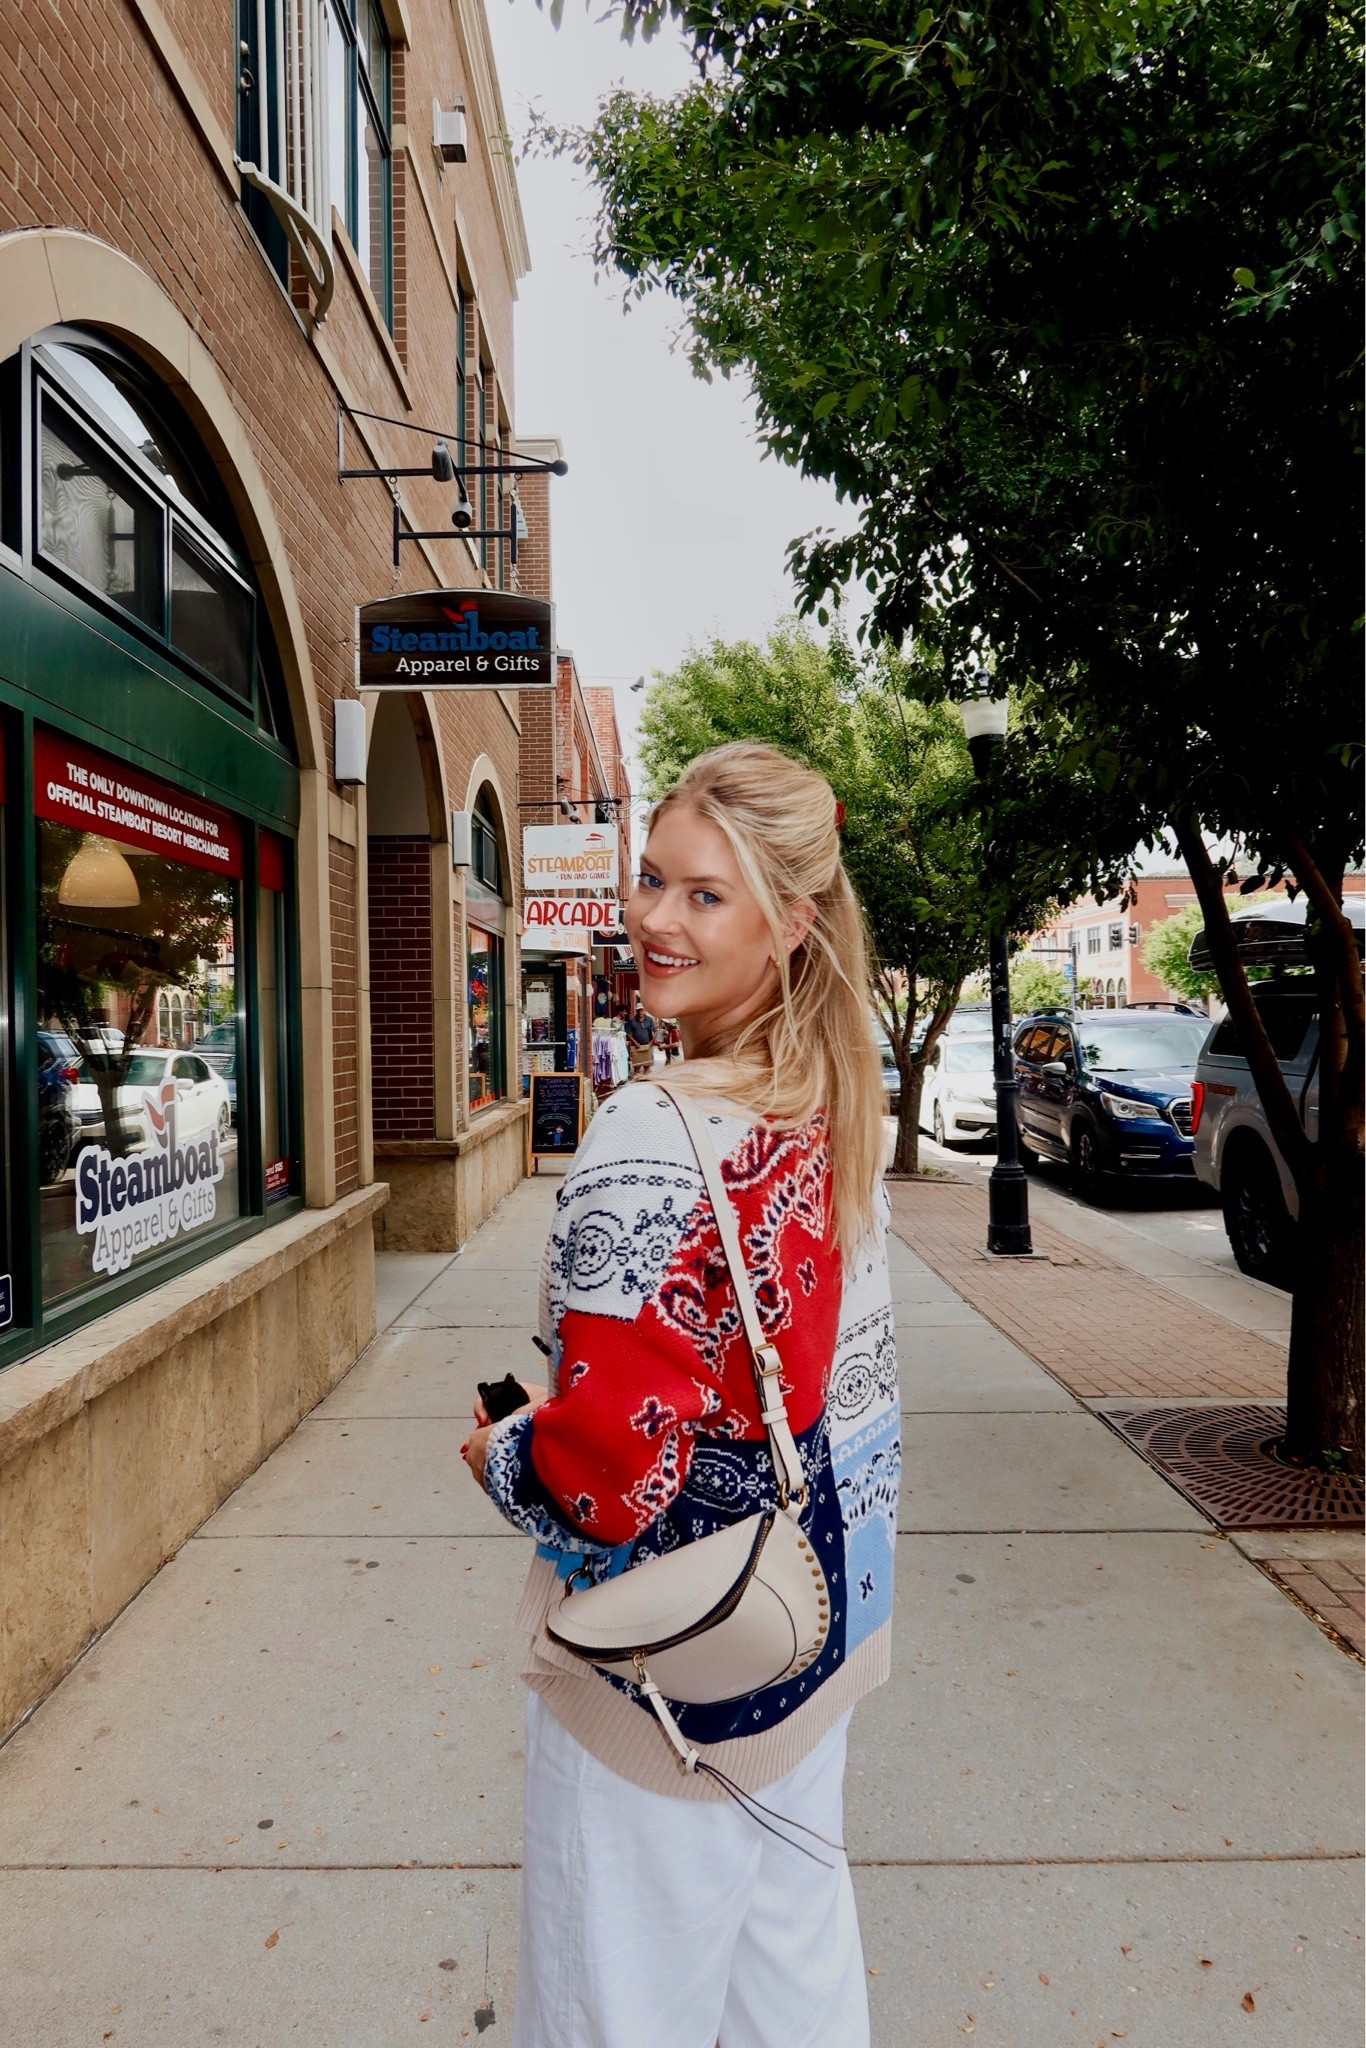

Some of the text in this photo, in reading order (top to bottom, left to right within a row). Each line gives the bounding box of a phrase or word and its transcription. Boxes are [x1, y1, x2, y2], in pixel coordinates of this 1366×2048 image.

[371, 611, 540, 654] Steamboat
[395, 655, 540, 676] Apparel & Gifts
[46, 781, 230, 862] OFFICIAL STEAMBOAT RESORT MERCHANDISE
[66, 762, 219, 838] THE ONLY DOWNTOWN LOCATION FOR
[527, 855, 614, 874] STEAMBOAT
[526, 900, 617, 928] ARCADE
[80, 1103, 219, 1225] Steamboat
[96, 1186, 214, 1265] Apparel & Gifts
